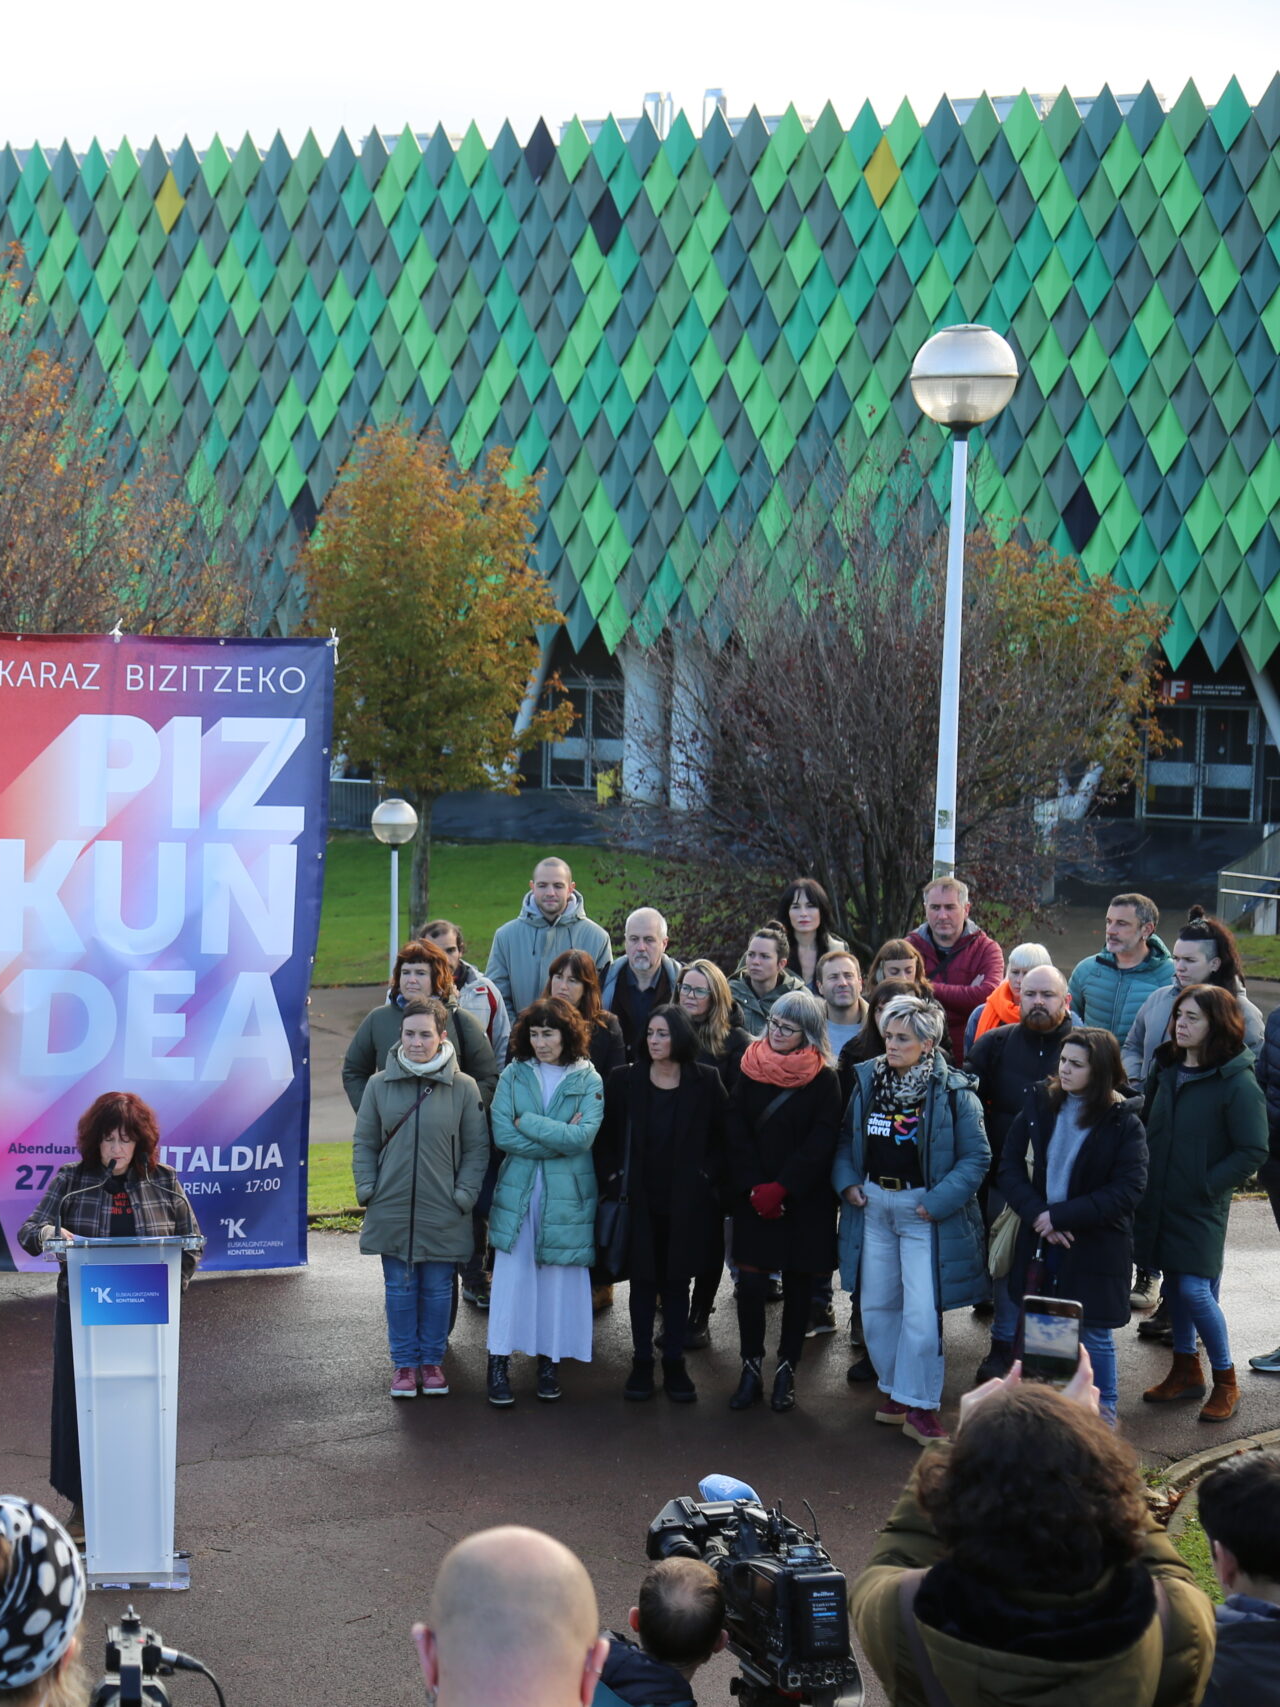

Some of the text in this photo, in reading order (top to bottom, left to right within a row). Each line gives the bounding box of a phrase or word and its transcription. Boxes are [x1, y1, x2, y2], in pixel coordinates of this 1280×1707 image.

[125, 664, 306, 694] BIZITZEKO
[1170, 681, 1185, 697] F
[78, 713, 306, 831] PIZ
[19, 968, 295, 1082] DEA
[8, 1142, 284, 1173] Abenduar ITALDIA
[15, 1165, 281, 1195] 27 RENA 17:00
